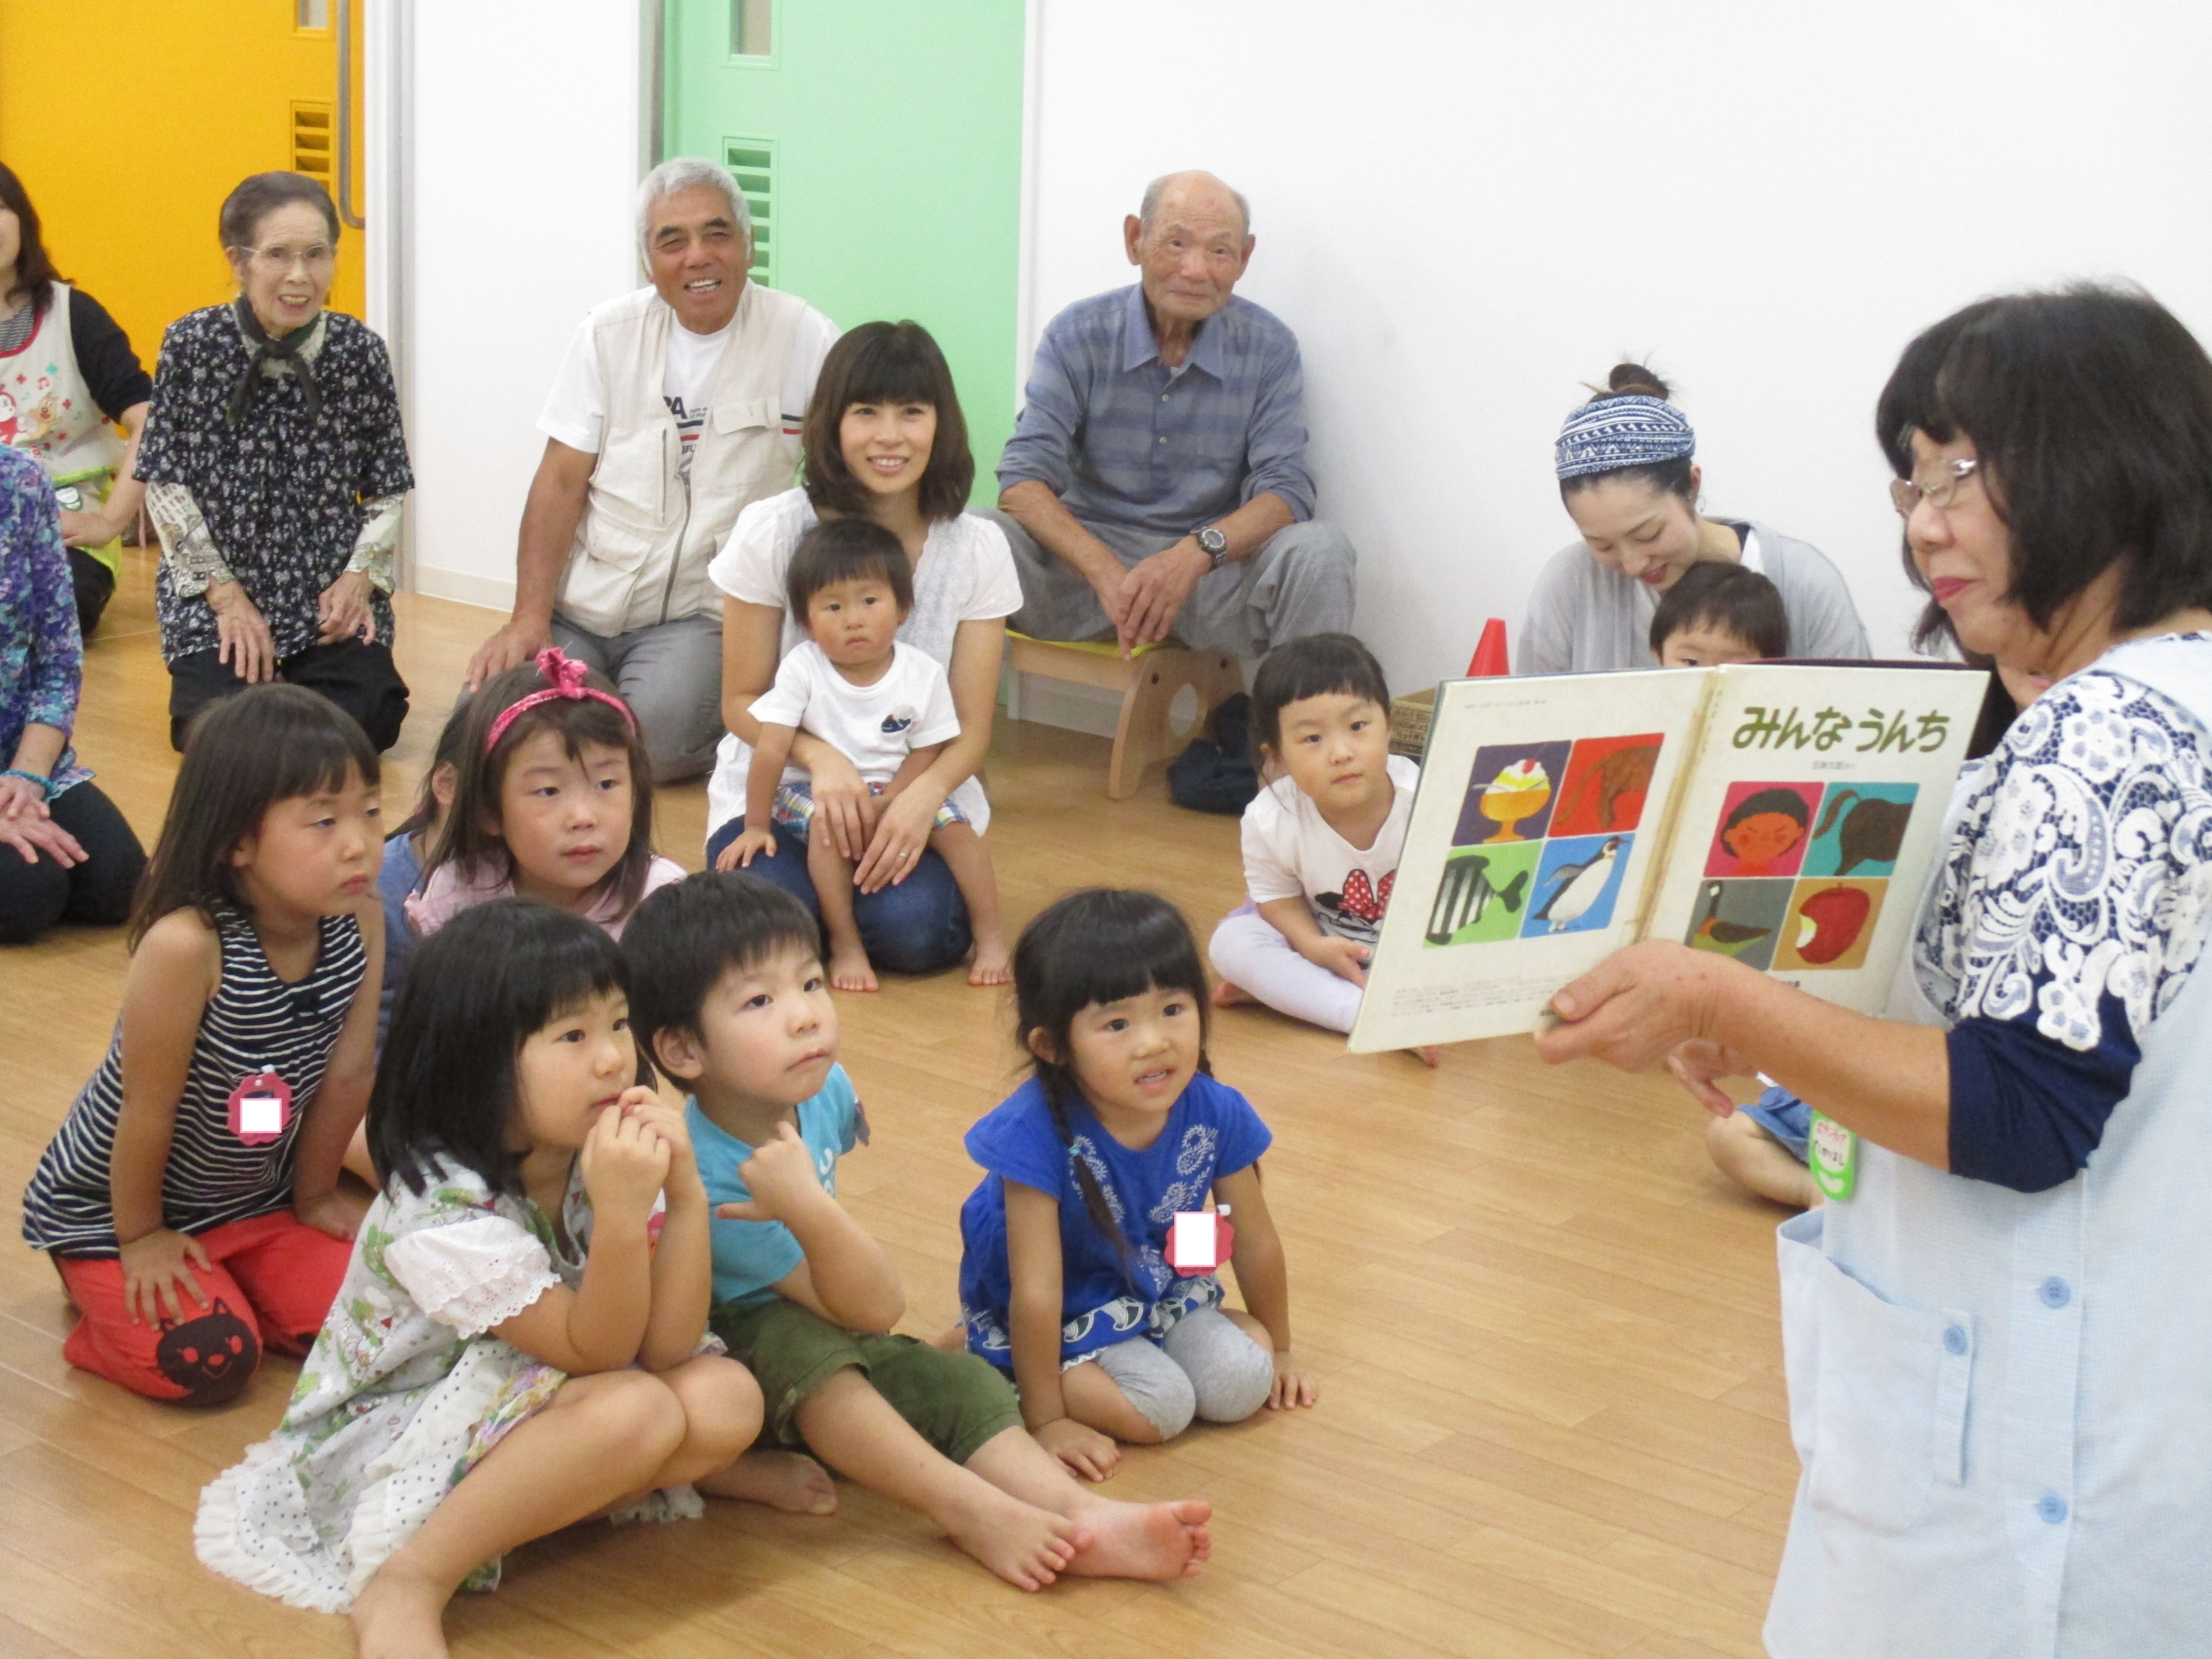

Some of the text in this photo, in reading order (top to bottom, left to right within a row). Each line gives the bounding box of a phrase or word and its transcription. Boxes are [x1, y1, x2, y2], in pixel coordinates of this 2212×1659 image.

[1732, 706, 1950, 753] みんなうんち
